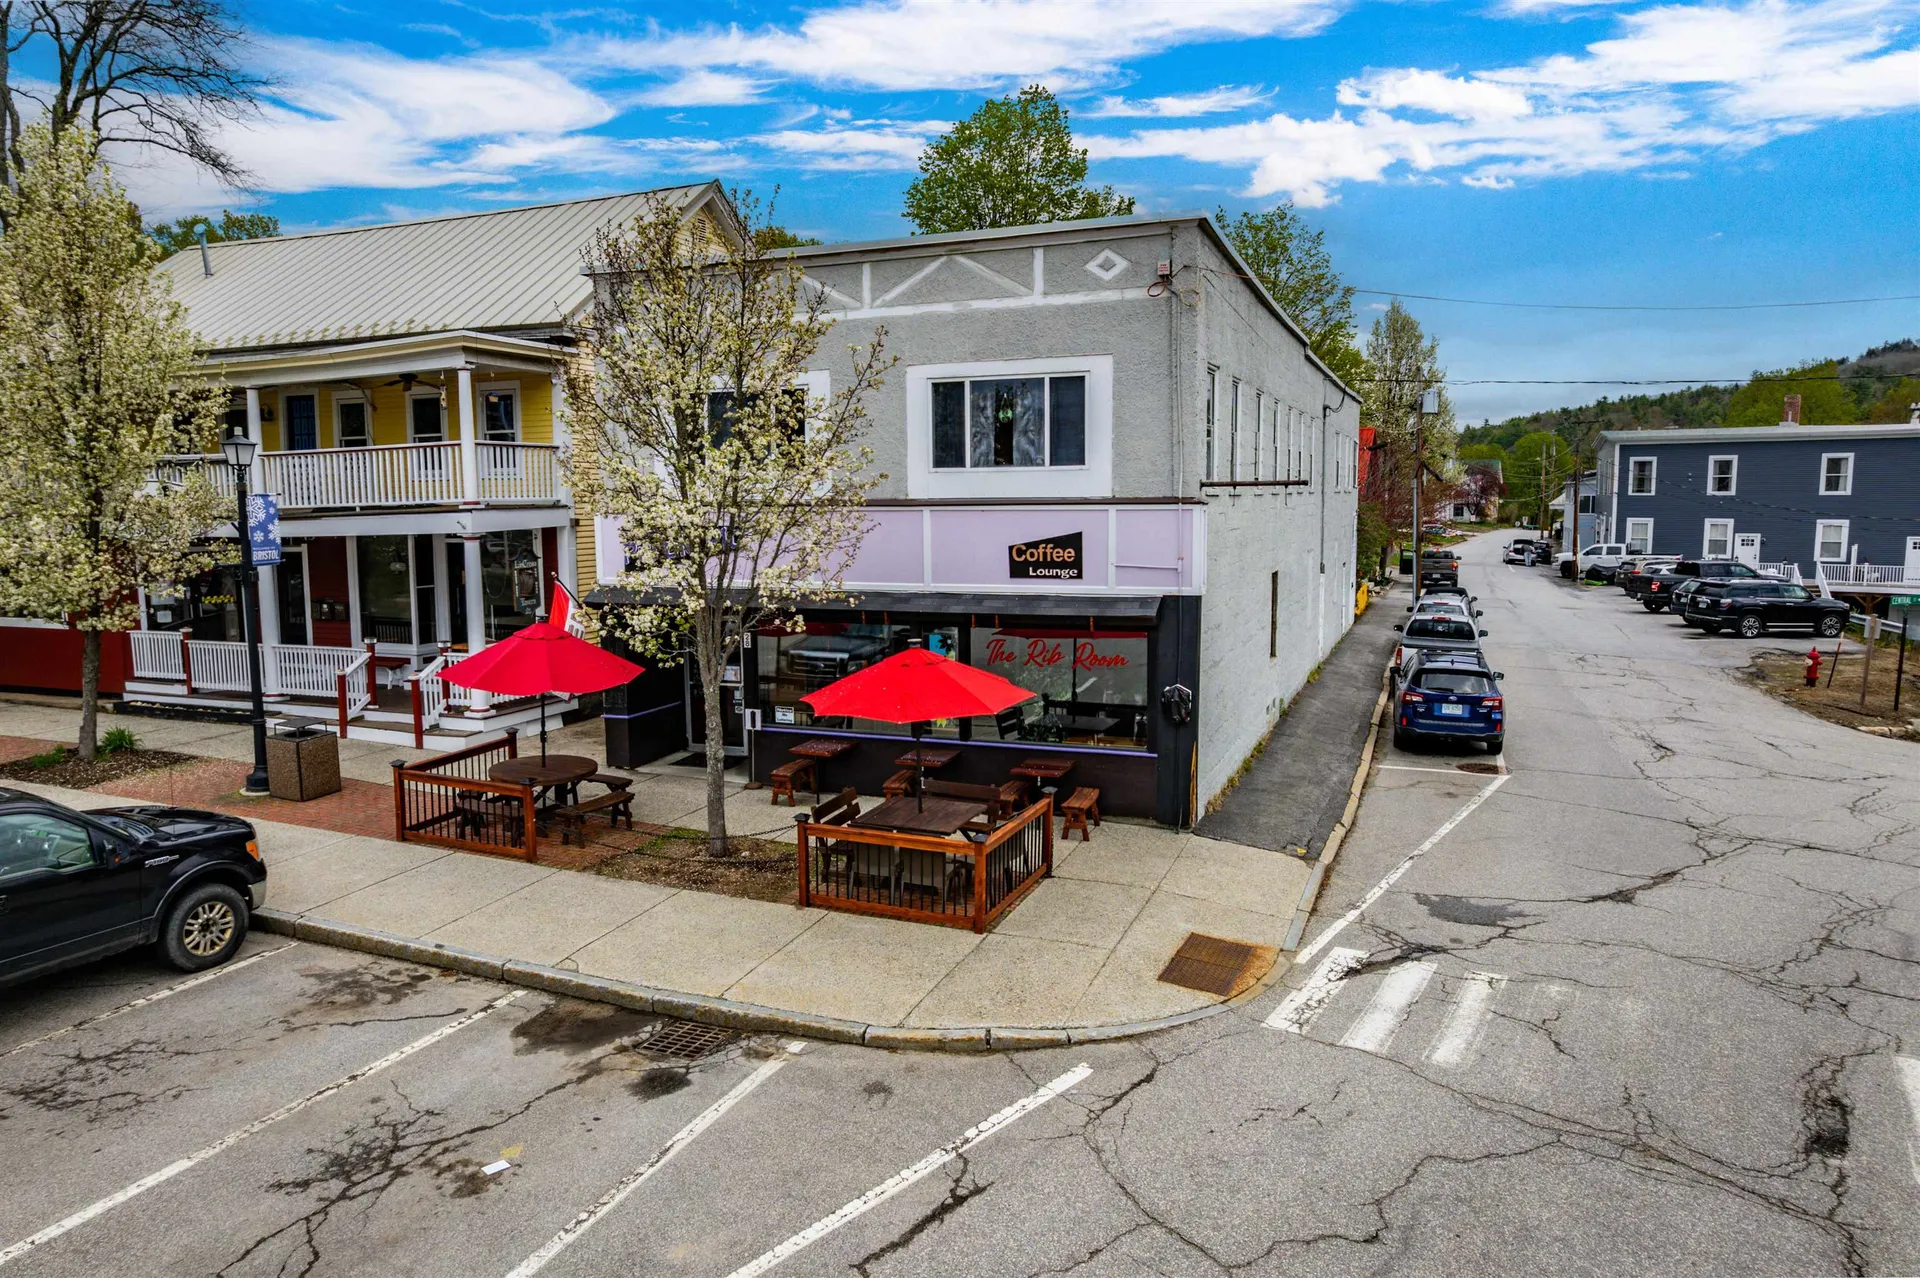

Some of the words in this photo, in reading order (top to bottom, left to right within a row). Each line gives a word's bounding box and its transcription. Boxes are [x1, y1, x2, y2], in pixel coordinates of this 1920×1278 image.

[253, 550, 279, 560] BRISTOL
[1012, 543, 1075, 562] Coffee
[1029, 566, 1078, 579] Lounge
[986, 639, 1017, 666] The
[1024, 639, 1065, 668] Rib
[1071, 641, 1130, 671] Room
